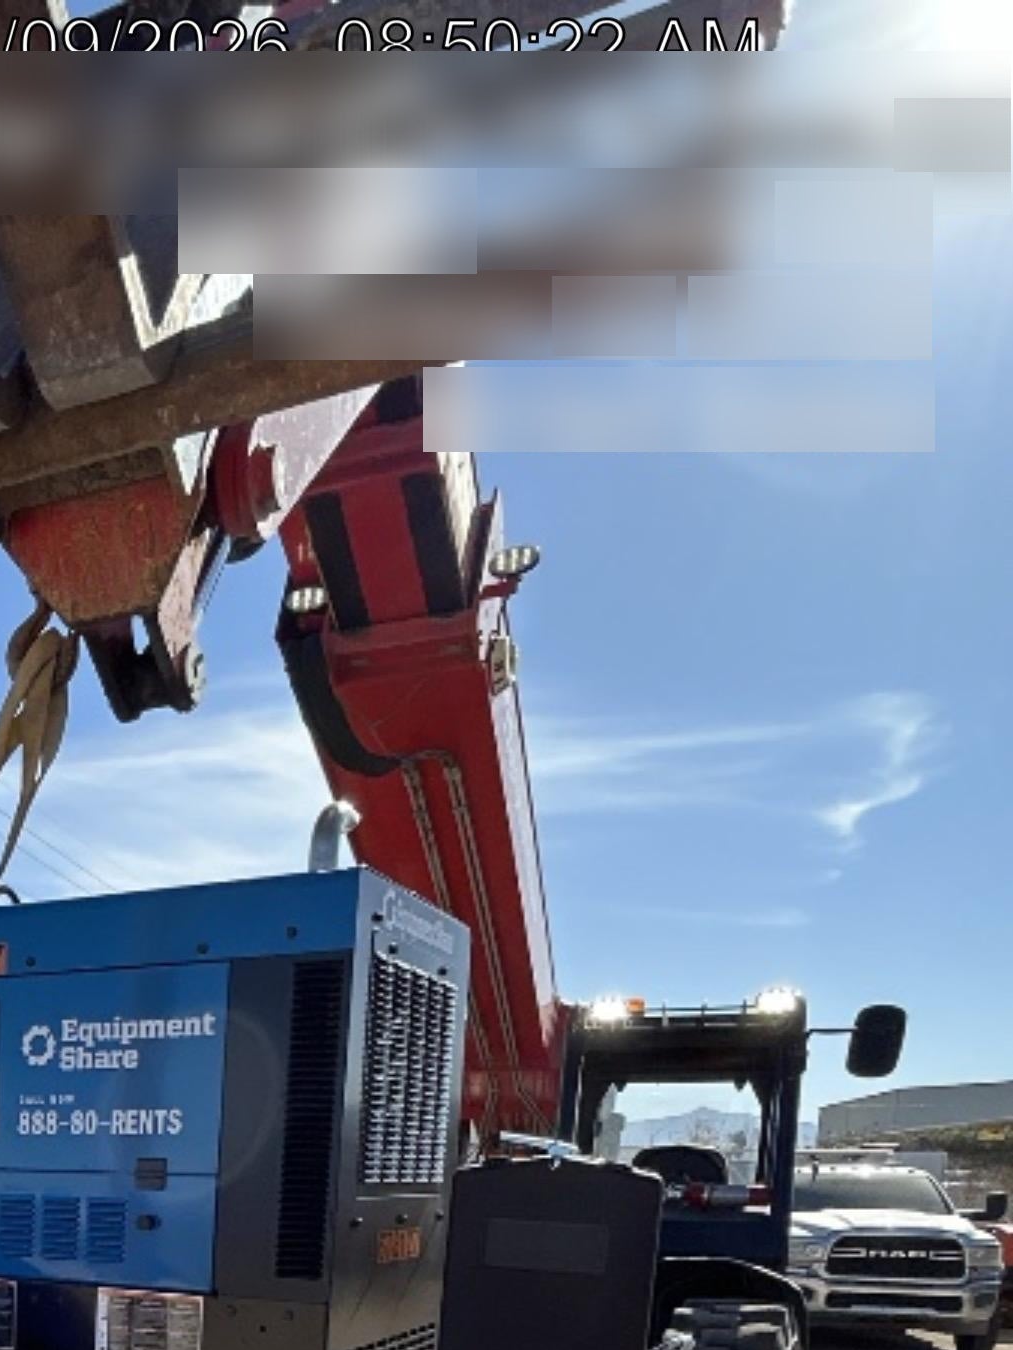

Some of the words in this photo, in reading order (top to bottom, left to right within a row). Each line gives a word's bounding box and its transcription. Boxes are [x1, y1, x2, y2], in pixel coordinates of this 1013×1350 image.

[61, 1013, 216, 1047] Equipment
[59, 1046, 138, 1071] Share
[18, 1109, 183, 1135] 888-80-RENTS
